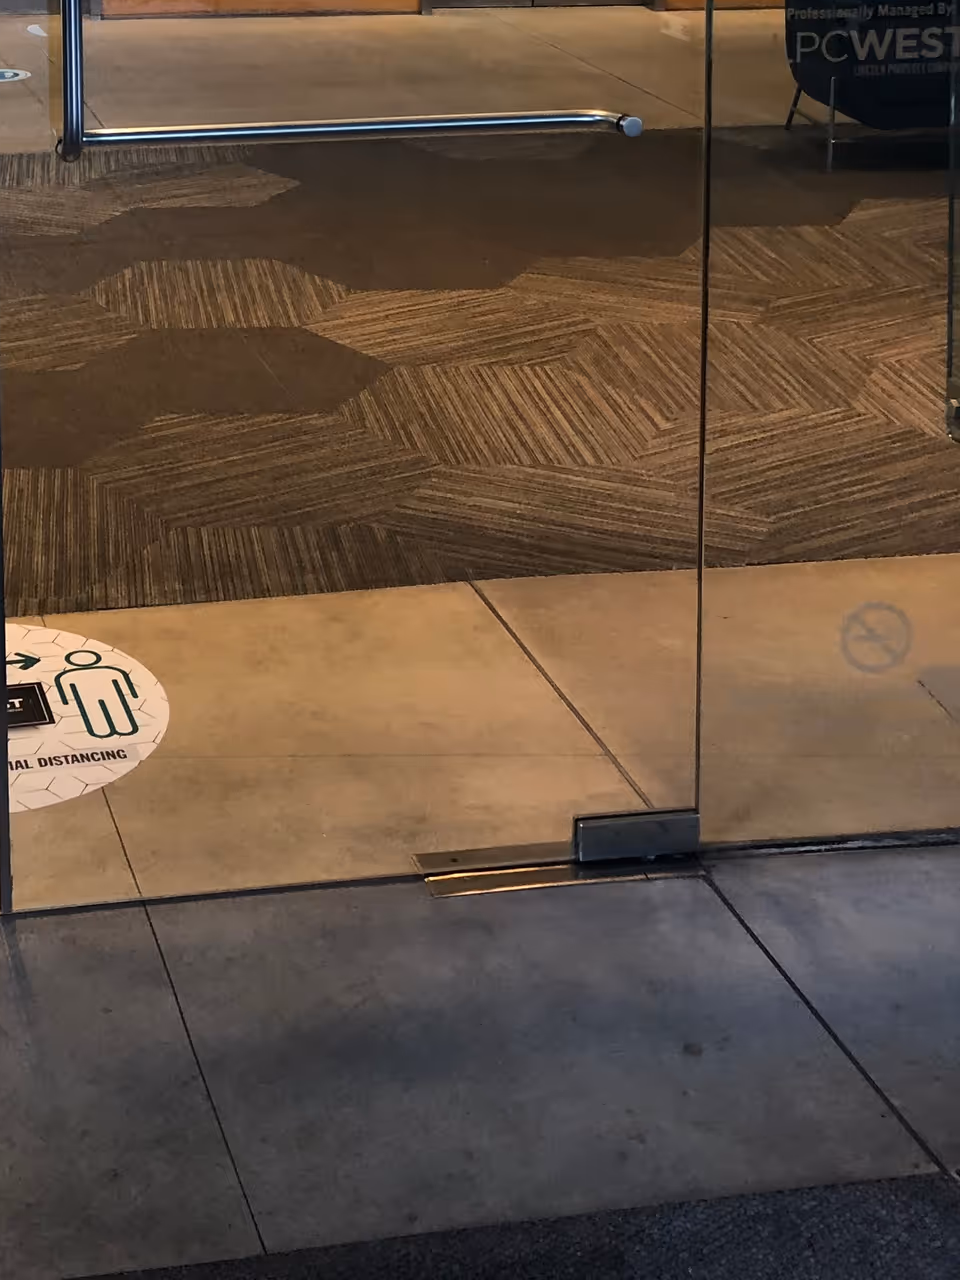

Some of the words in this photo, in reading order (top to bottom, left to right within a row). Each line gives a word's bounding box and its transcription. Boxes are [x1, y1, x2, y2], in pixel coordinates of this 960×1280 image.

[787, 5, 874, 21] Professionally
[878, 3, 934, 18] Managed
[37, 748, 128, 768] DISTANCING
